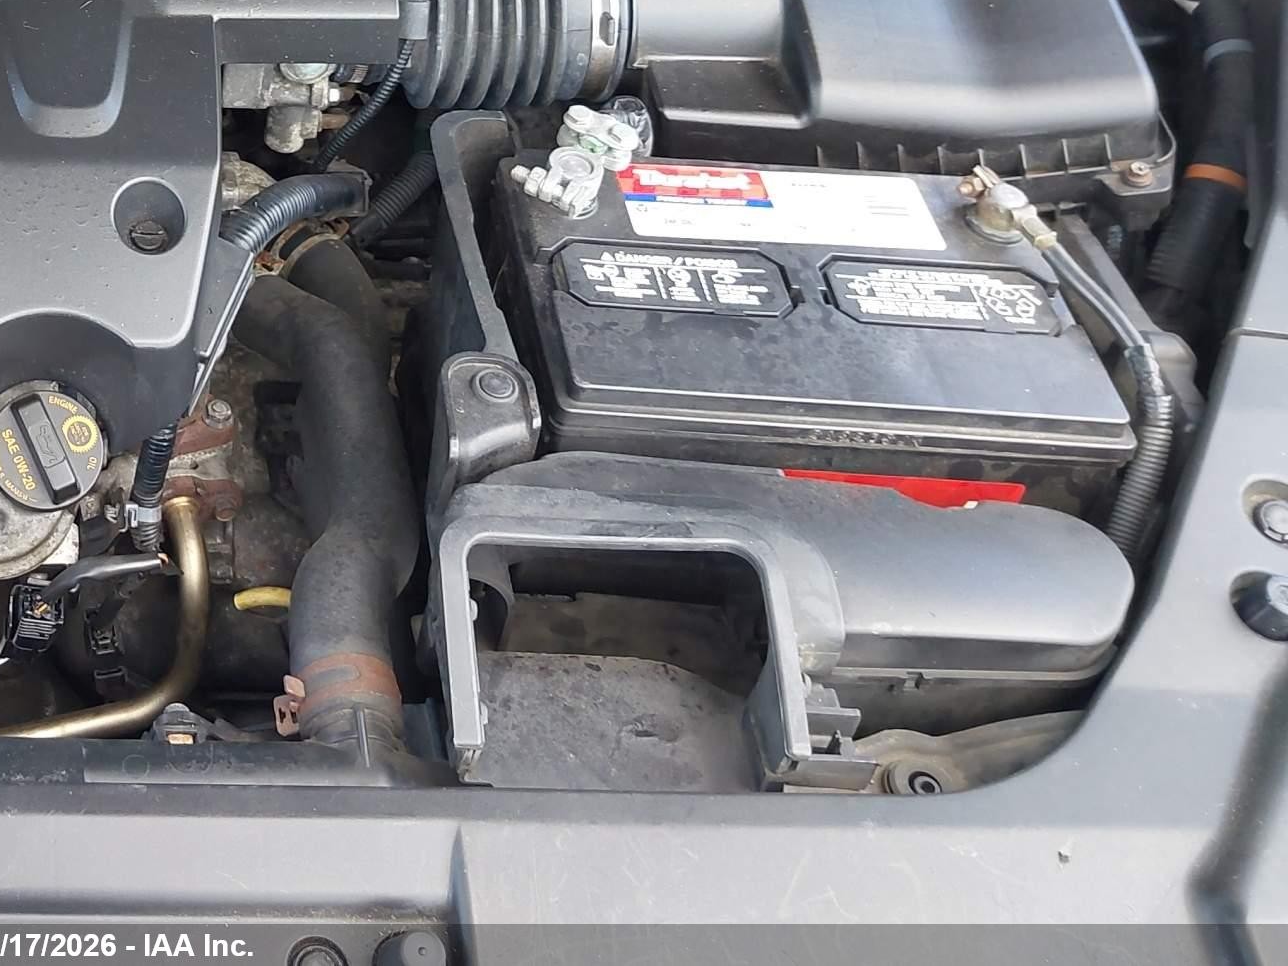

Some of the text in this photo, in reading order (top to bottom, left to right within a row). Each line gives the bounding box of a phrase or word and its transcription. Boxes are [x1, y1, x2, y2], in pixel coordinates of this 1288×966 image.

[48, 395, 80, 415] ENGINE
[1, 428, 37, 491] SAE 0W-20
[86, 456, 98, 471] OIL
